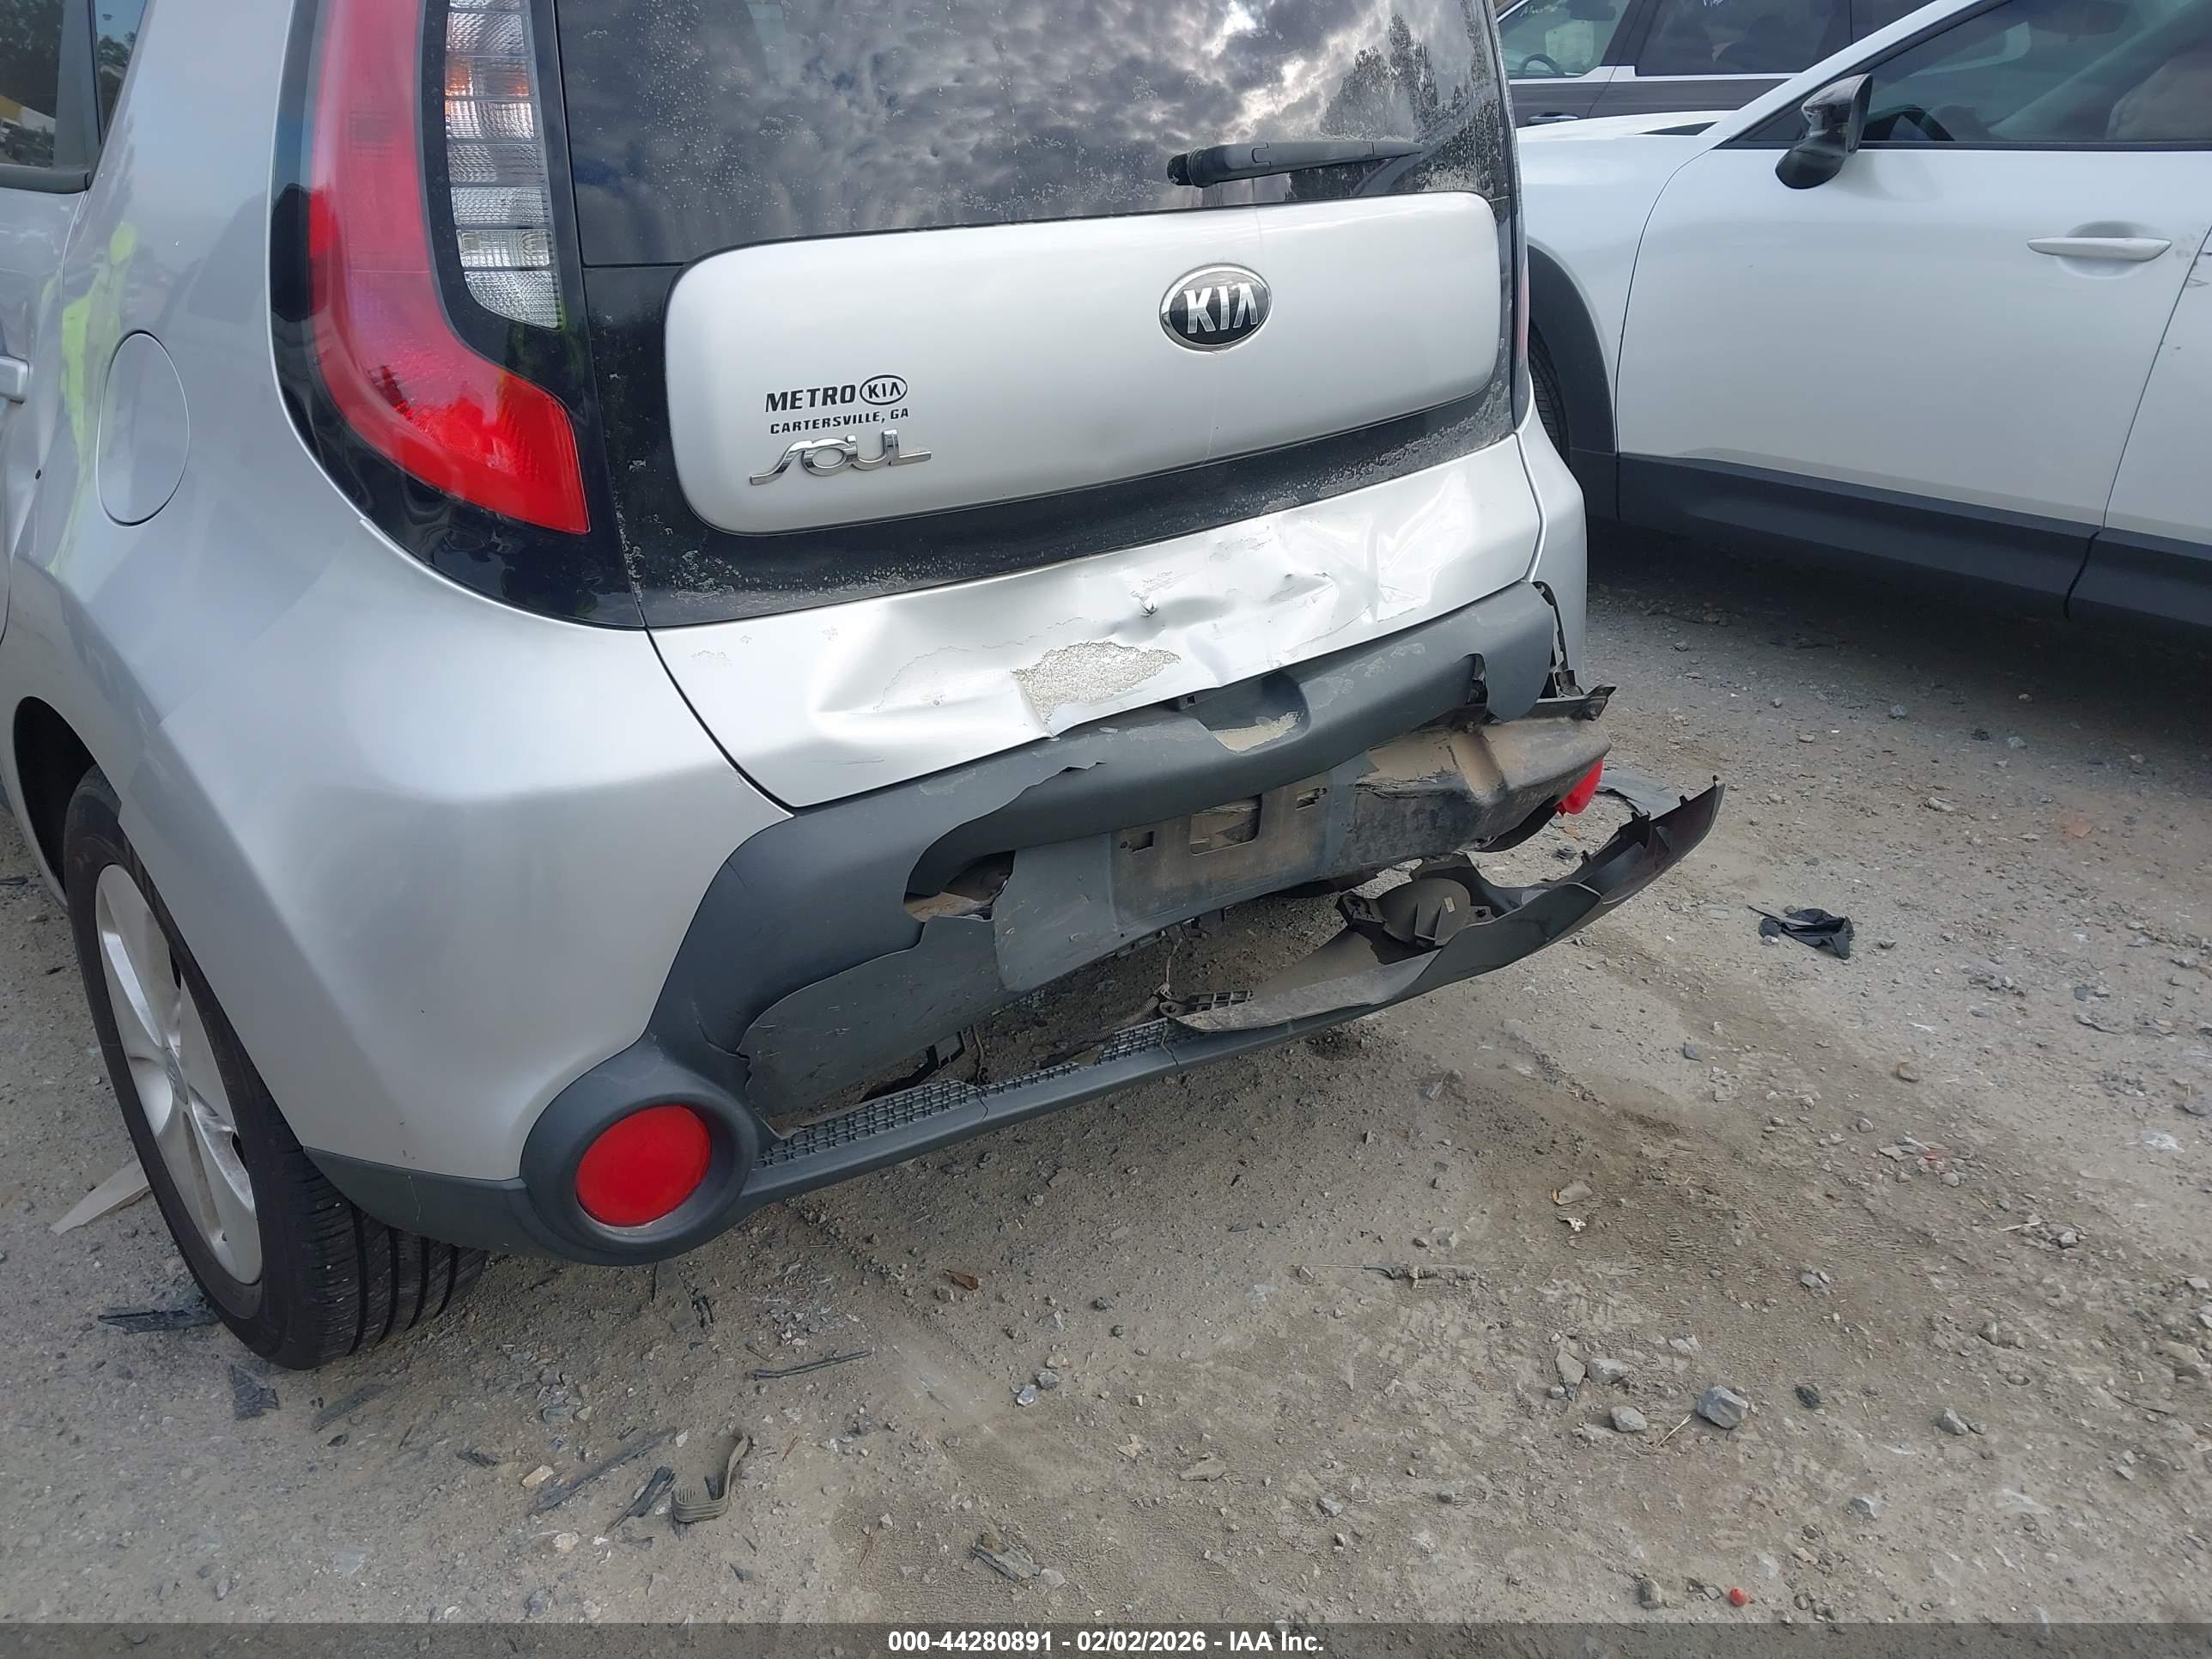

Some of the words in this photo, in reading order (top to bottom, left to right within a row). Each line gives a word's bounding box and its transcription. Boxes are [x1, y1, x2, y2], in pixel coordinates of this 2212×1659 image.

[1183, 283, 1259, 334] KIA
[765, 384, 856, 413] METRO
[866, 380, 902, 400] KIA
[769, 410, 886, 434] CARTERSVILLE,
[890, 407, 909, 421] GA
[749, 428, 933, 486] SOUL
